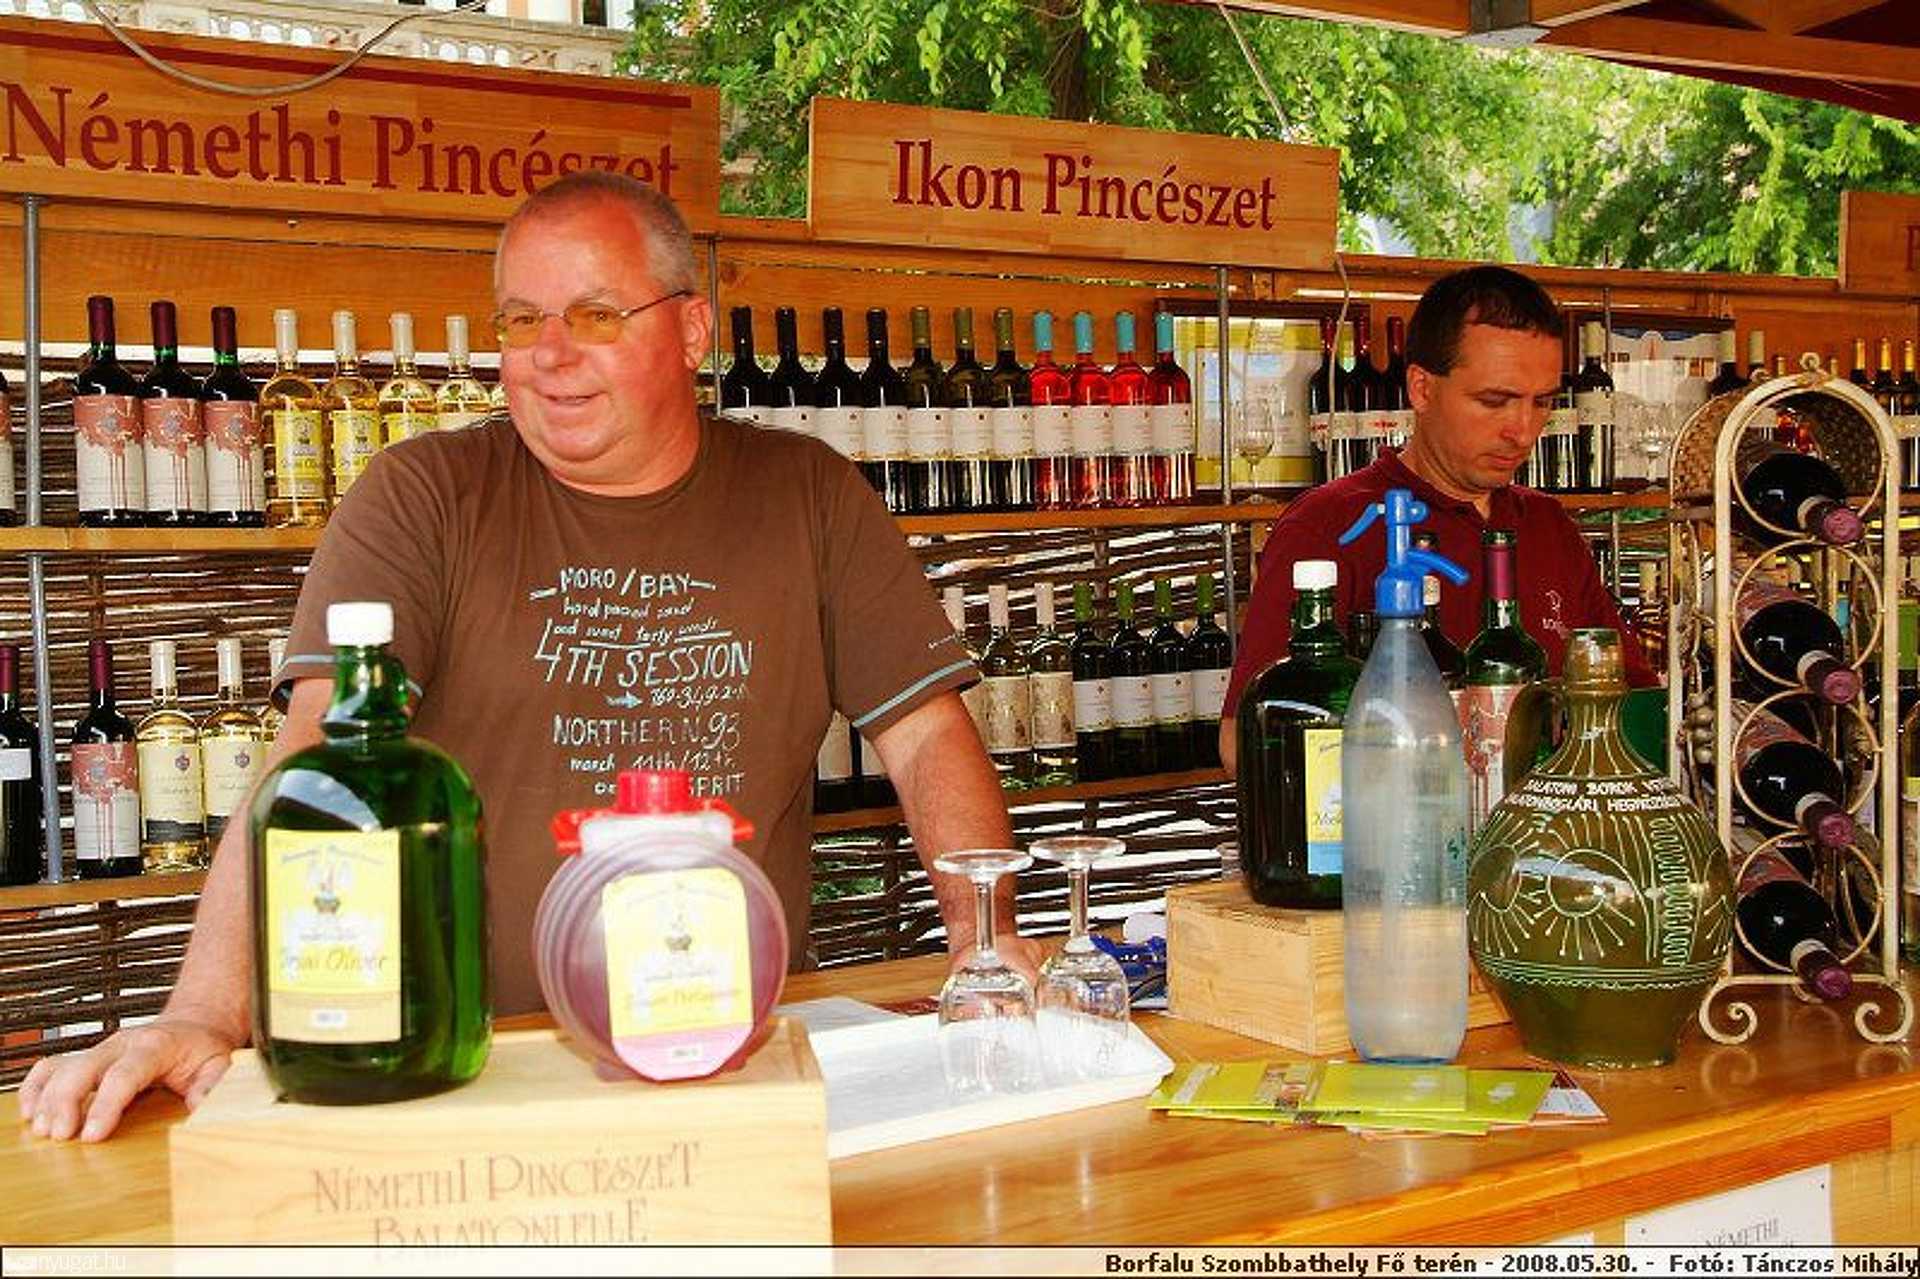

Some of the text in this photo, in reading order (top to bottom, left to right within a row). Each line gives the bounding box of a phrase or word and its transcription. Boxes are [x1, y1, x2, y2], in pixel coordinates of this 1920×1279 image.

[2, 81, 680, 198] Némethi Pincéet
[892, 138, 1277, 232] Ikon Pincészet
[535, 618, 752, 687] 4TH SESSION
[487, 1140, 700, 1202] PINCÉSZET
